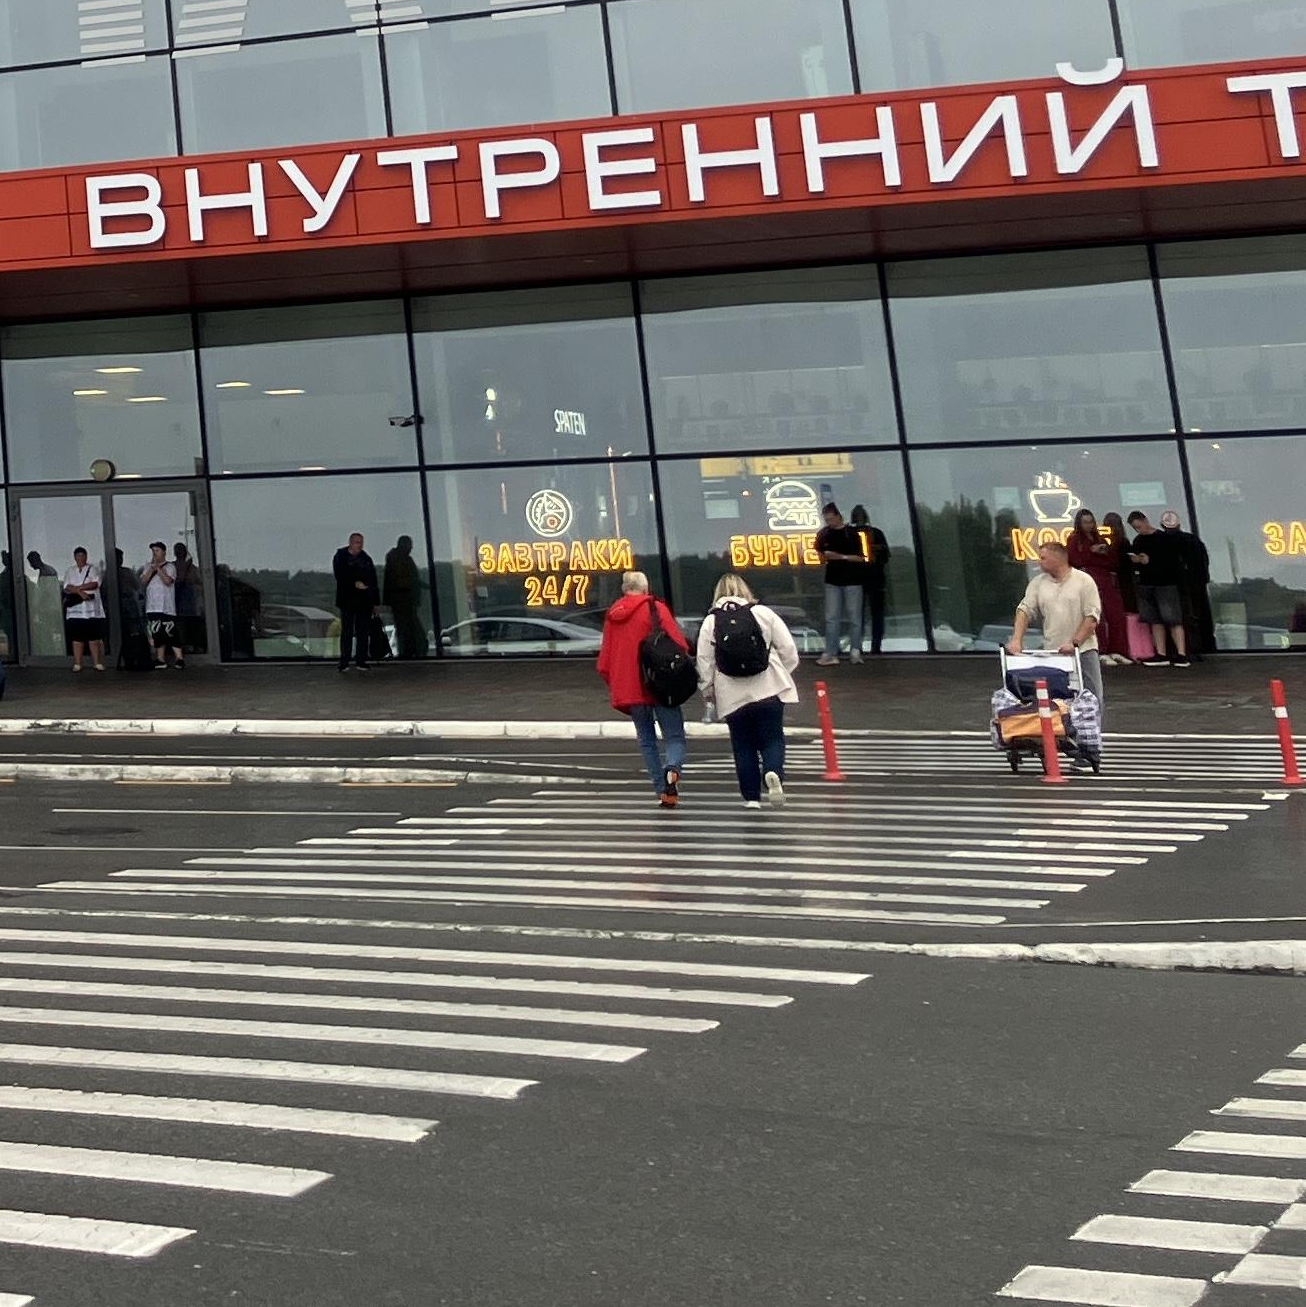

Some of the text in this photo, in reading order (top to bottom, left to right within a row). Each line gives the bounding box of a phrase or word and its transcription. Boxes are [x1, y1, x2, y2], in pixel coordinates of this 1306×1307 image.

[84, 57, 1158, 248] ВНУТРЕННИЙ
[554, 408, 587, 436] SPATEN
[478, 538, 634, 574] ЗАВТРАКИ
[523, 574, 590, 607] 24/7
